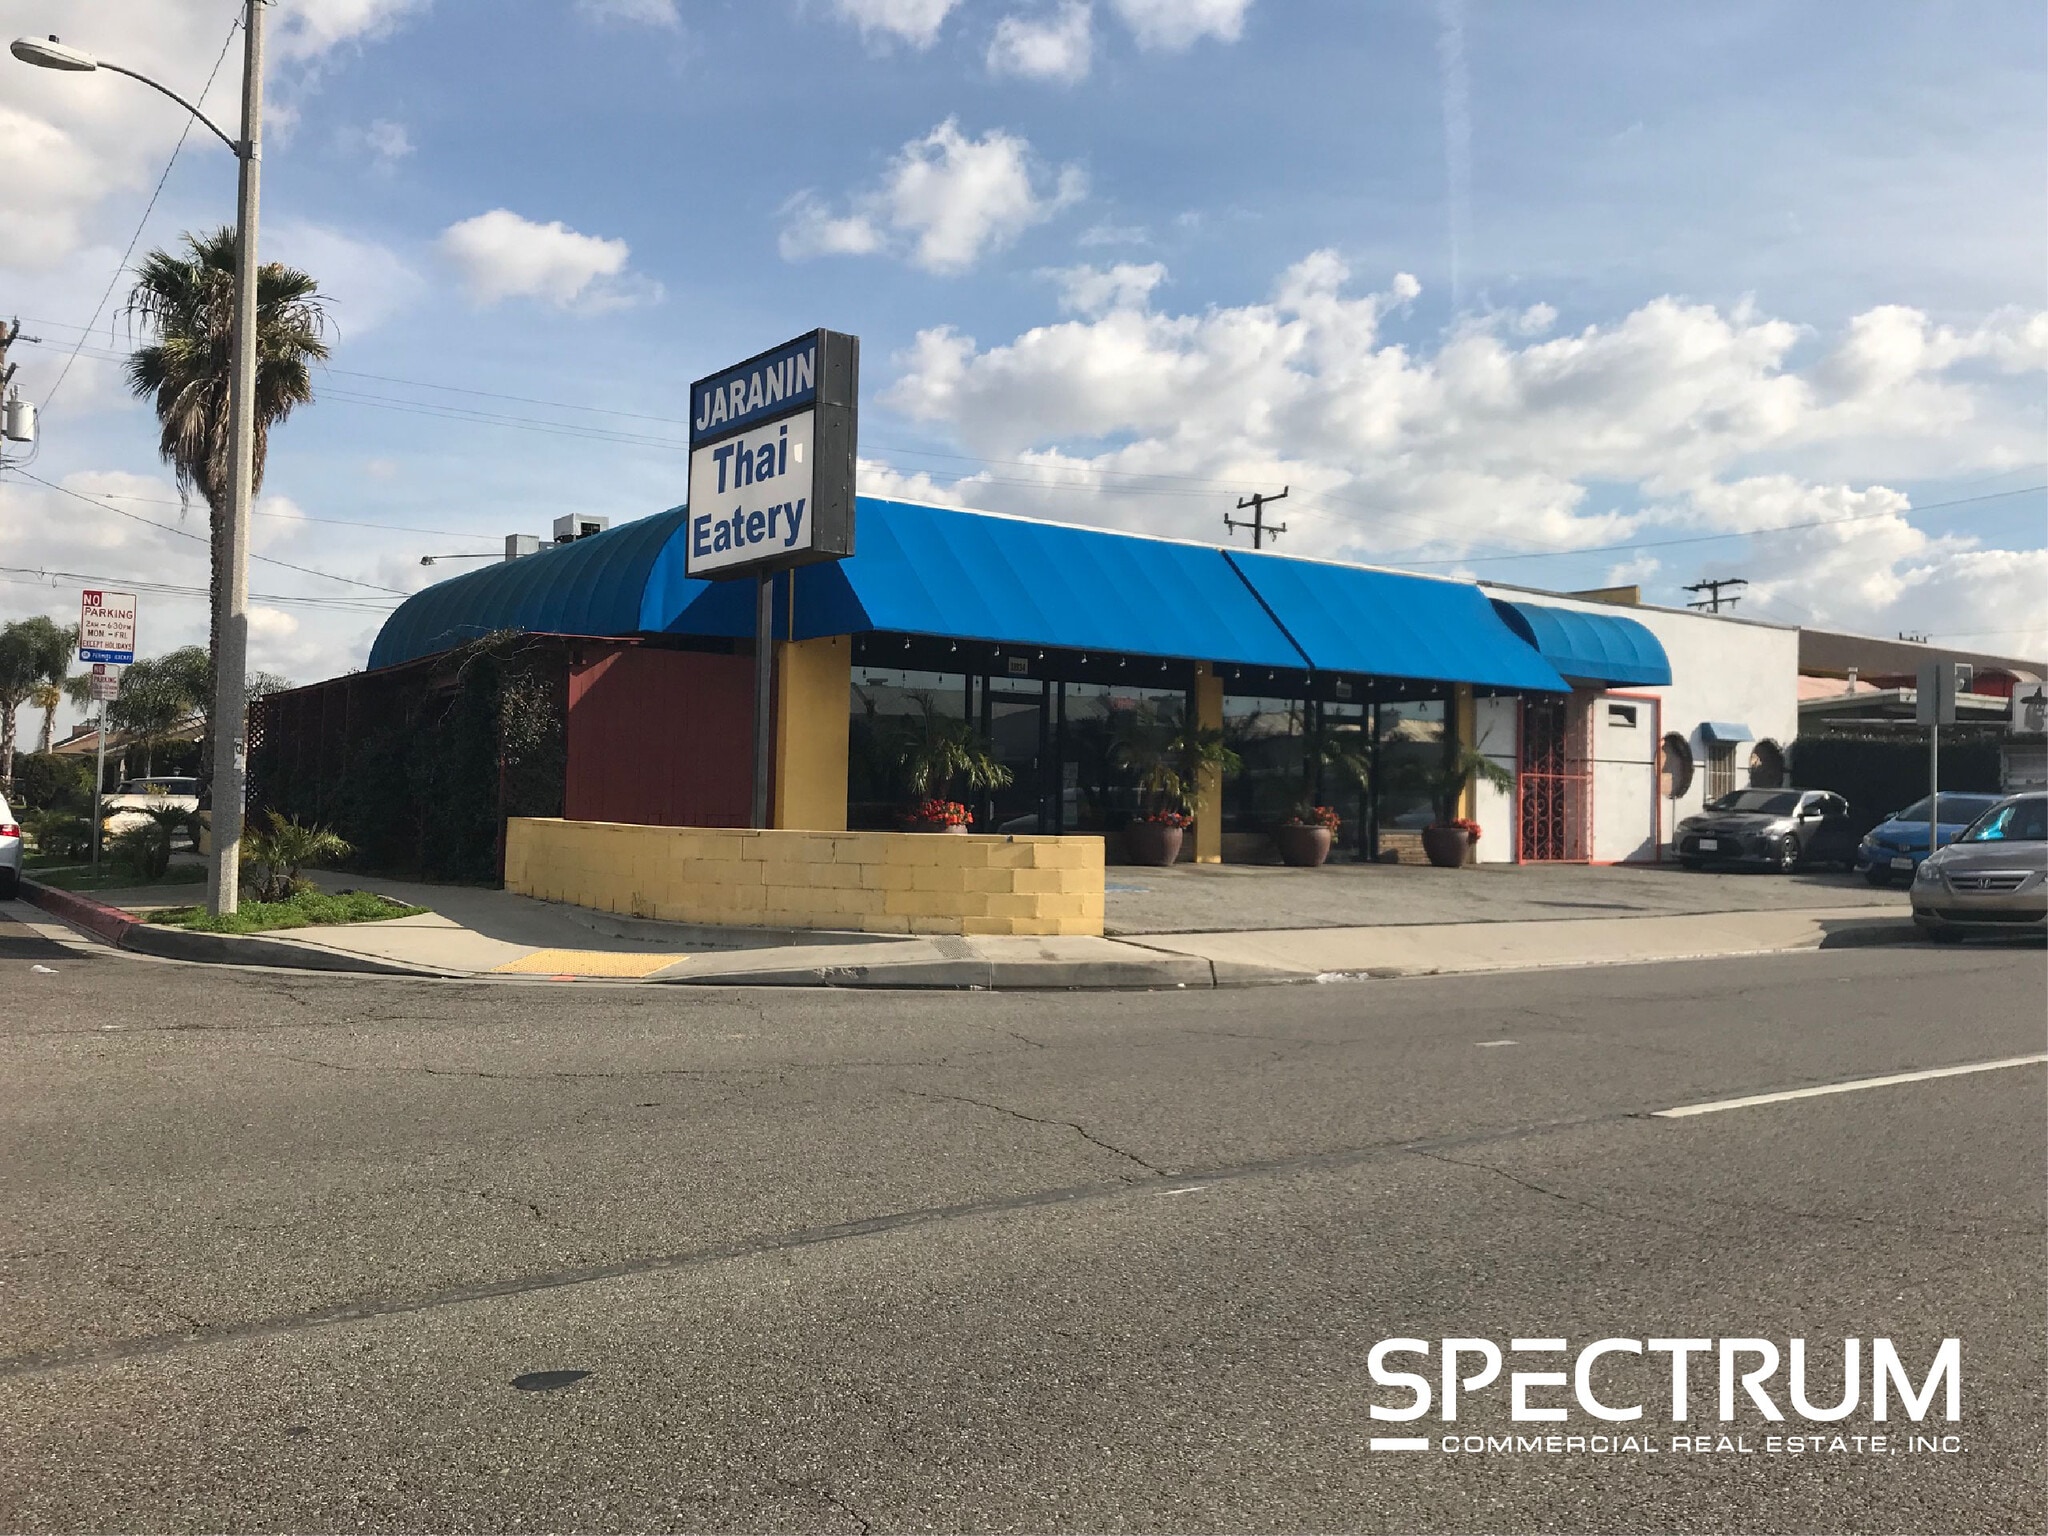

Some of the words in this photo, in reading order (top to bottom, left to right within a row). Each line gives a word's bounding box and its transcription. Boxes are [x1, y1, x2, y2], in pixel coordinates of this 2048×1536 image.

[696, 347, 816, 431] JARANIN
[712, 424, 788, 495] Thai
[693, 498, 806, 559] Eatery
[83, 594, 101, 606] NO
[84, 607, 133, 620] PARKING
